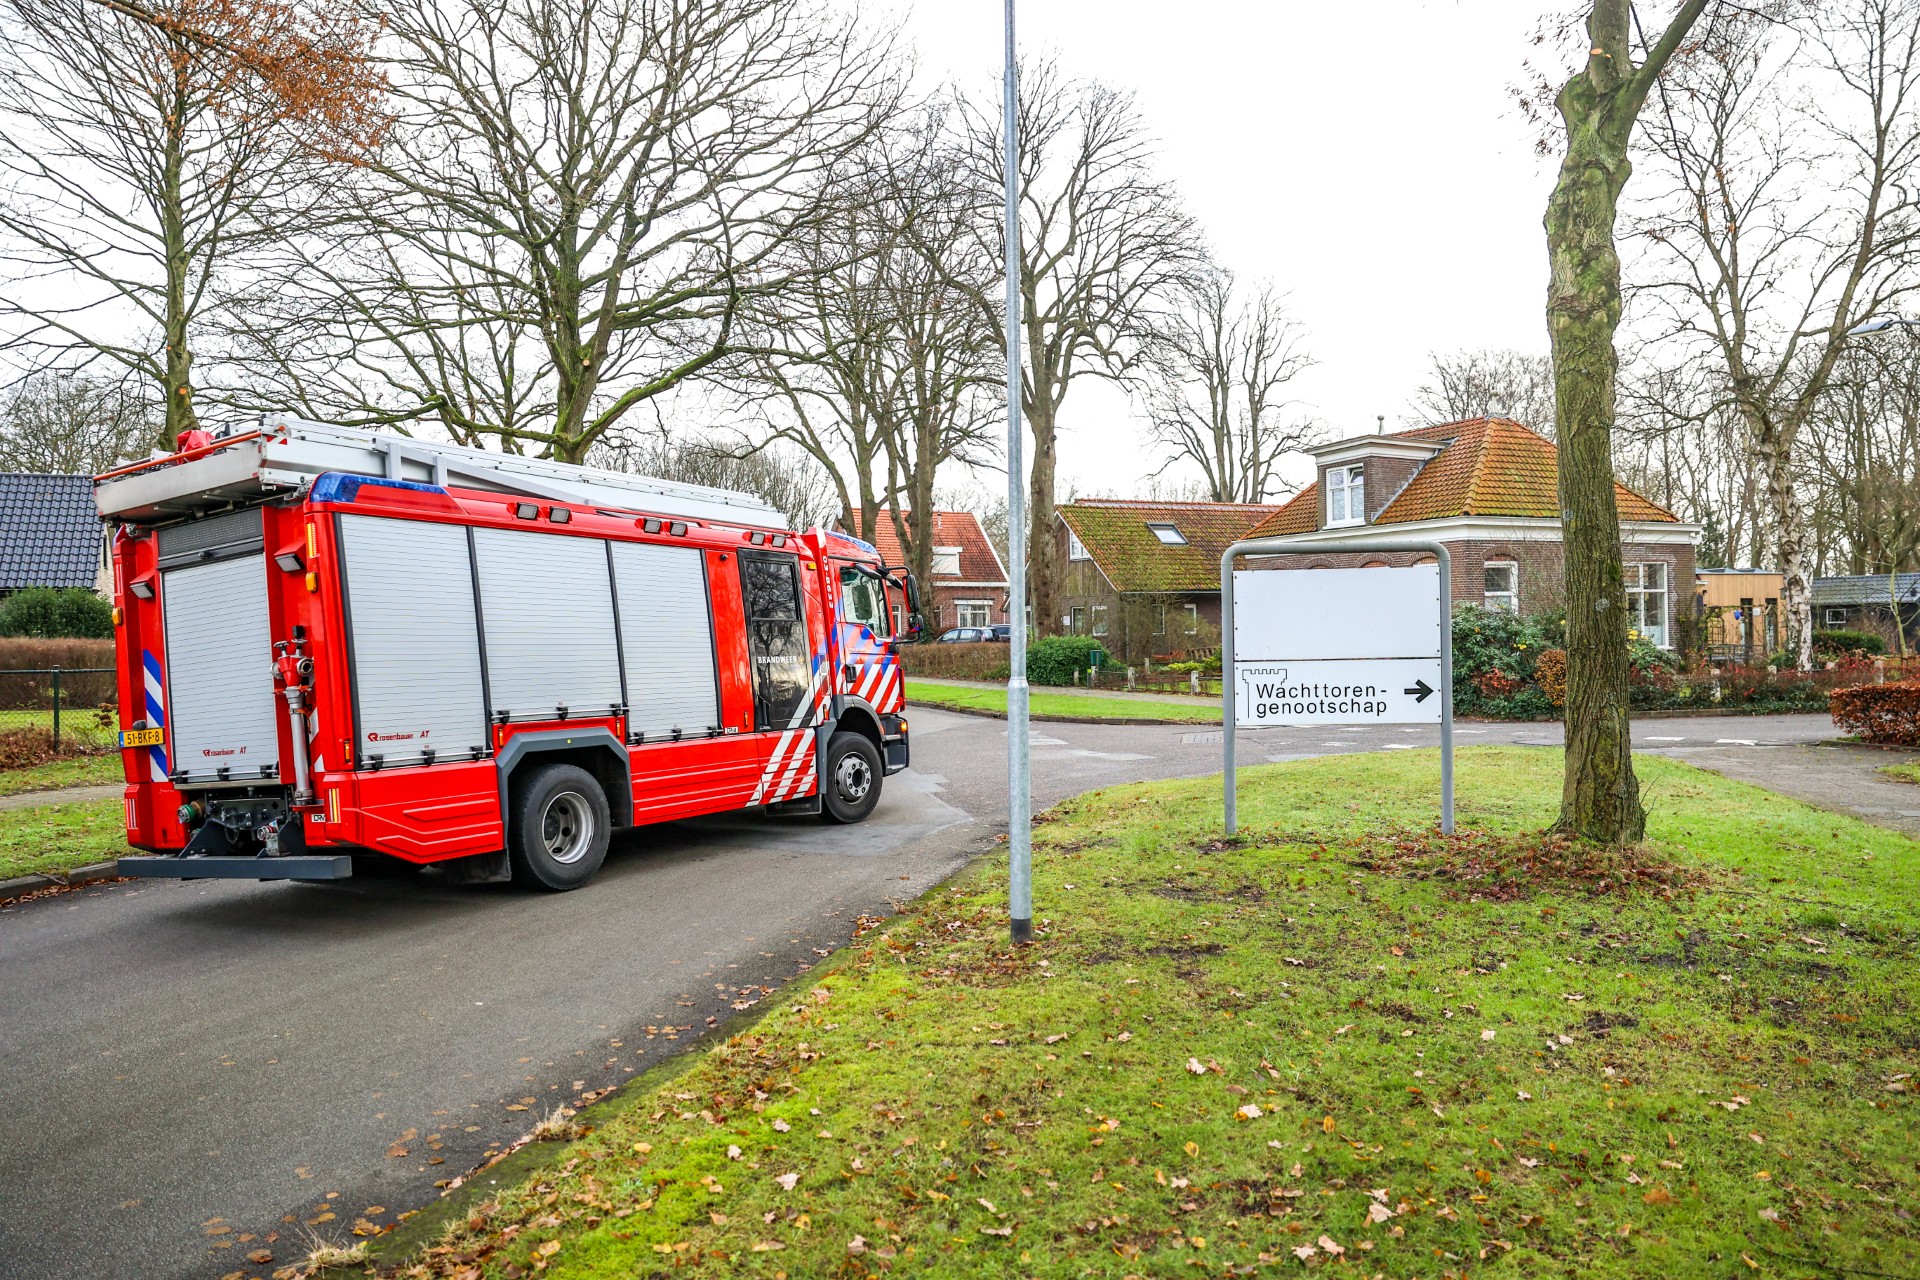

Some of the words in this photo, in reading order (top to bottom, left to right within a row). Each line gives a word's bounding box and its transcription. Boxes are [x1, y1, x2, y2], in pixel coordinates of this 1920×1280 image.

[757, 655, 797, 664] BRANDWEER
[1256, 683, 1387, 699] Wachttoren-
[1256, 698, 1387, 718] genootschap
[127, 731, 160, 745] 51-BKF-8
[420, 730, 430, 738] AT
